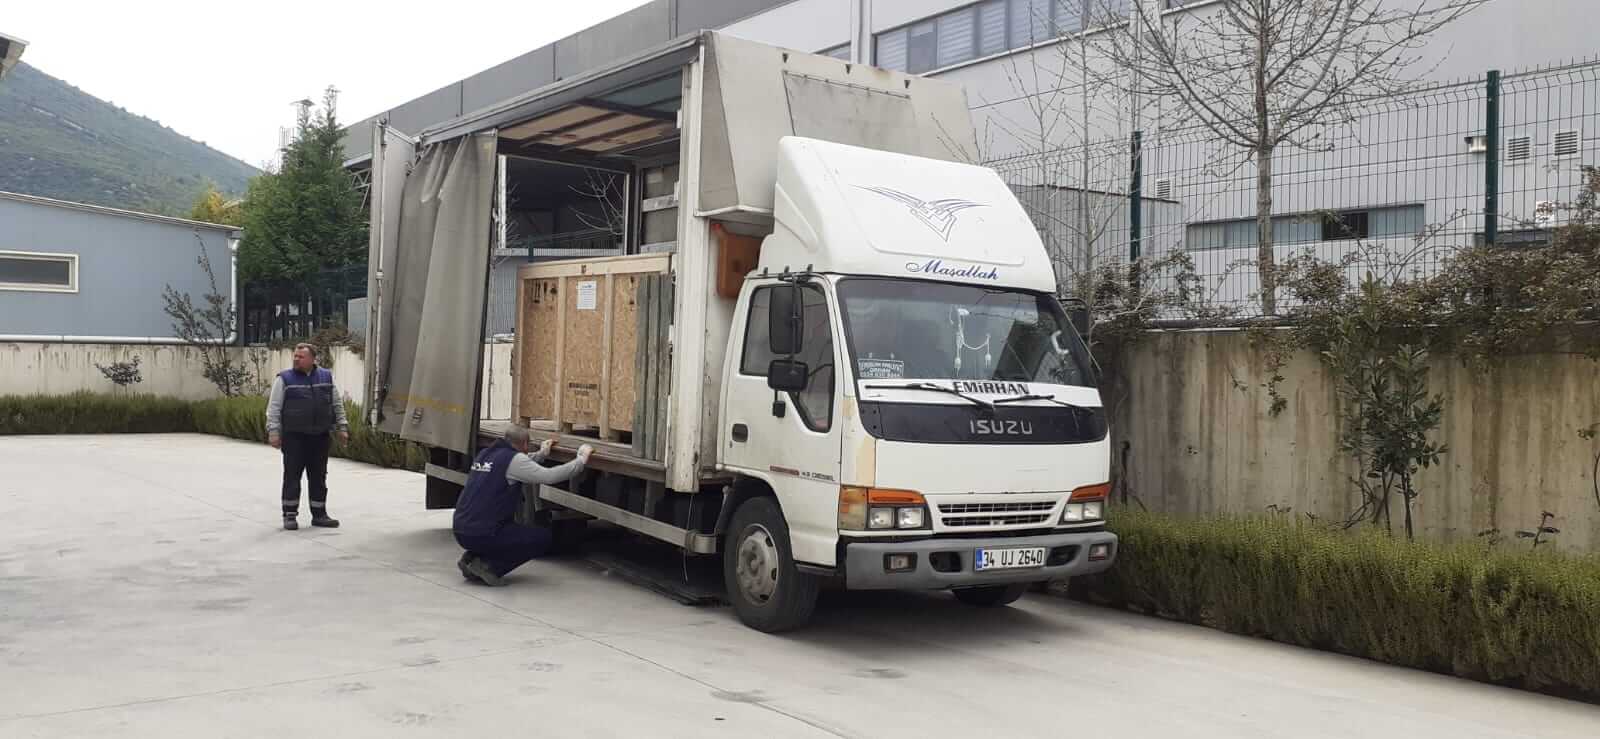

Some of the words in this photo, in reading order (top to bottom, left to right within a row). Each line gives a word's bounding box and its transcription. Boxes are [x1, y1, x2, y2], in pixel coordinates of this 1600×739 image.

[969, 419, 1033, 435] ISUZU
[983, 551, 995, 567] 34
[1001, 550, 1014, 566] UJ
[1018, 549, 1043, 565] 2640
